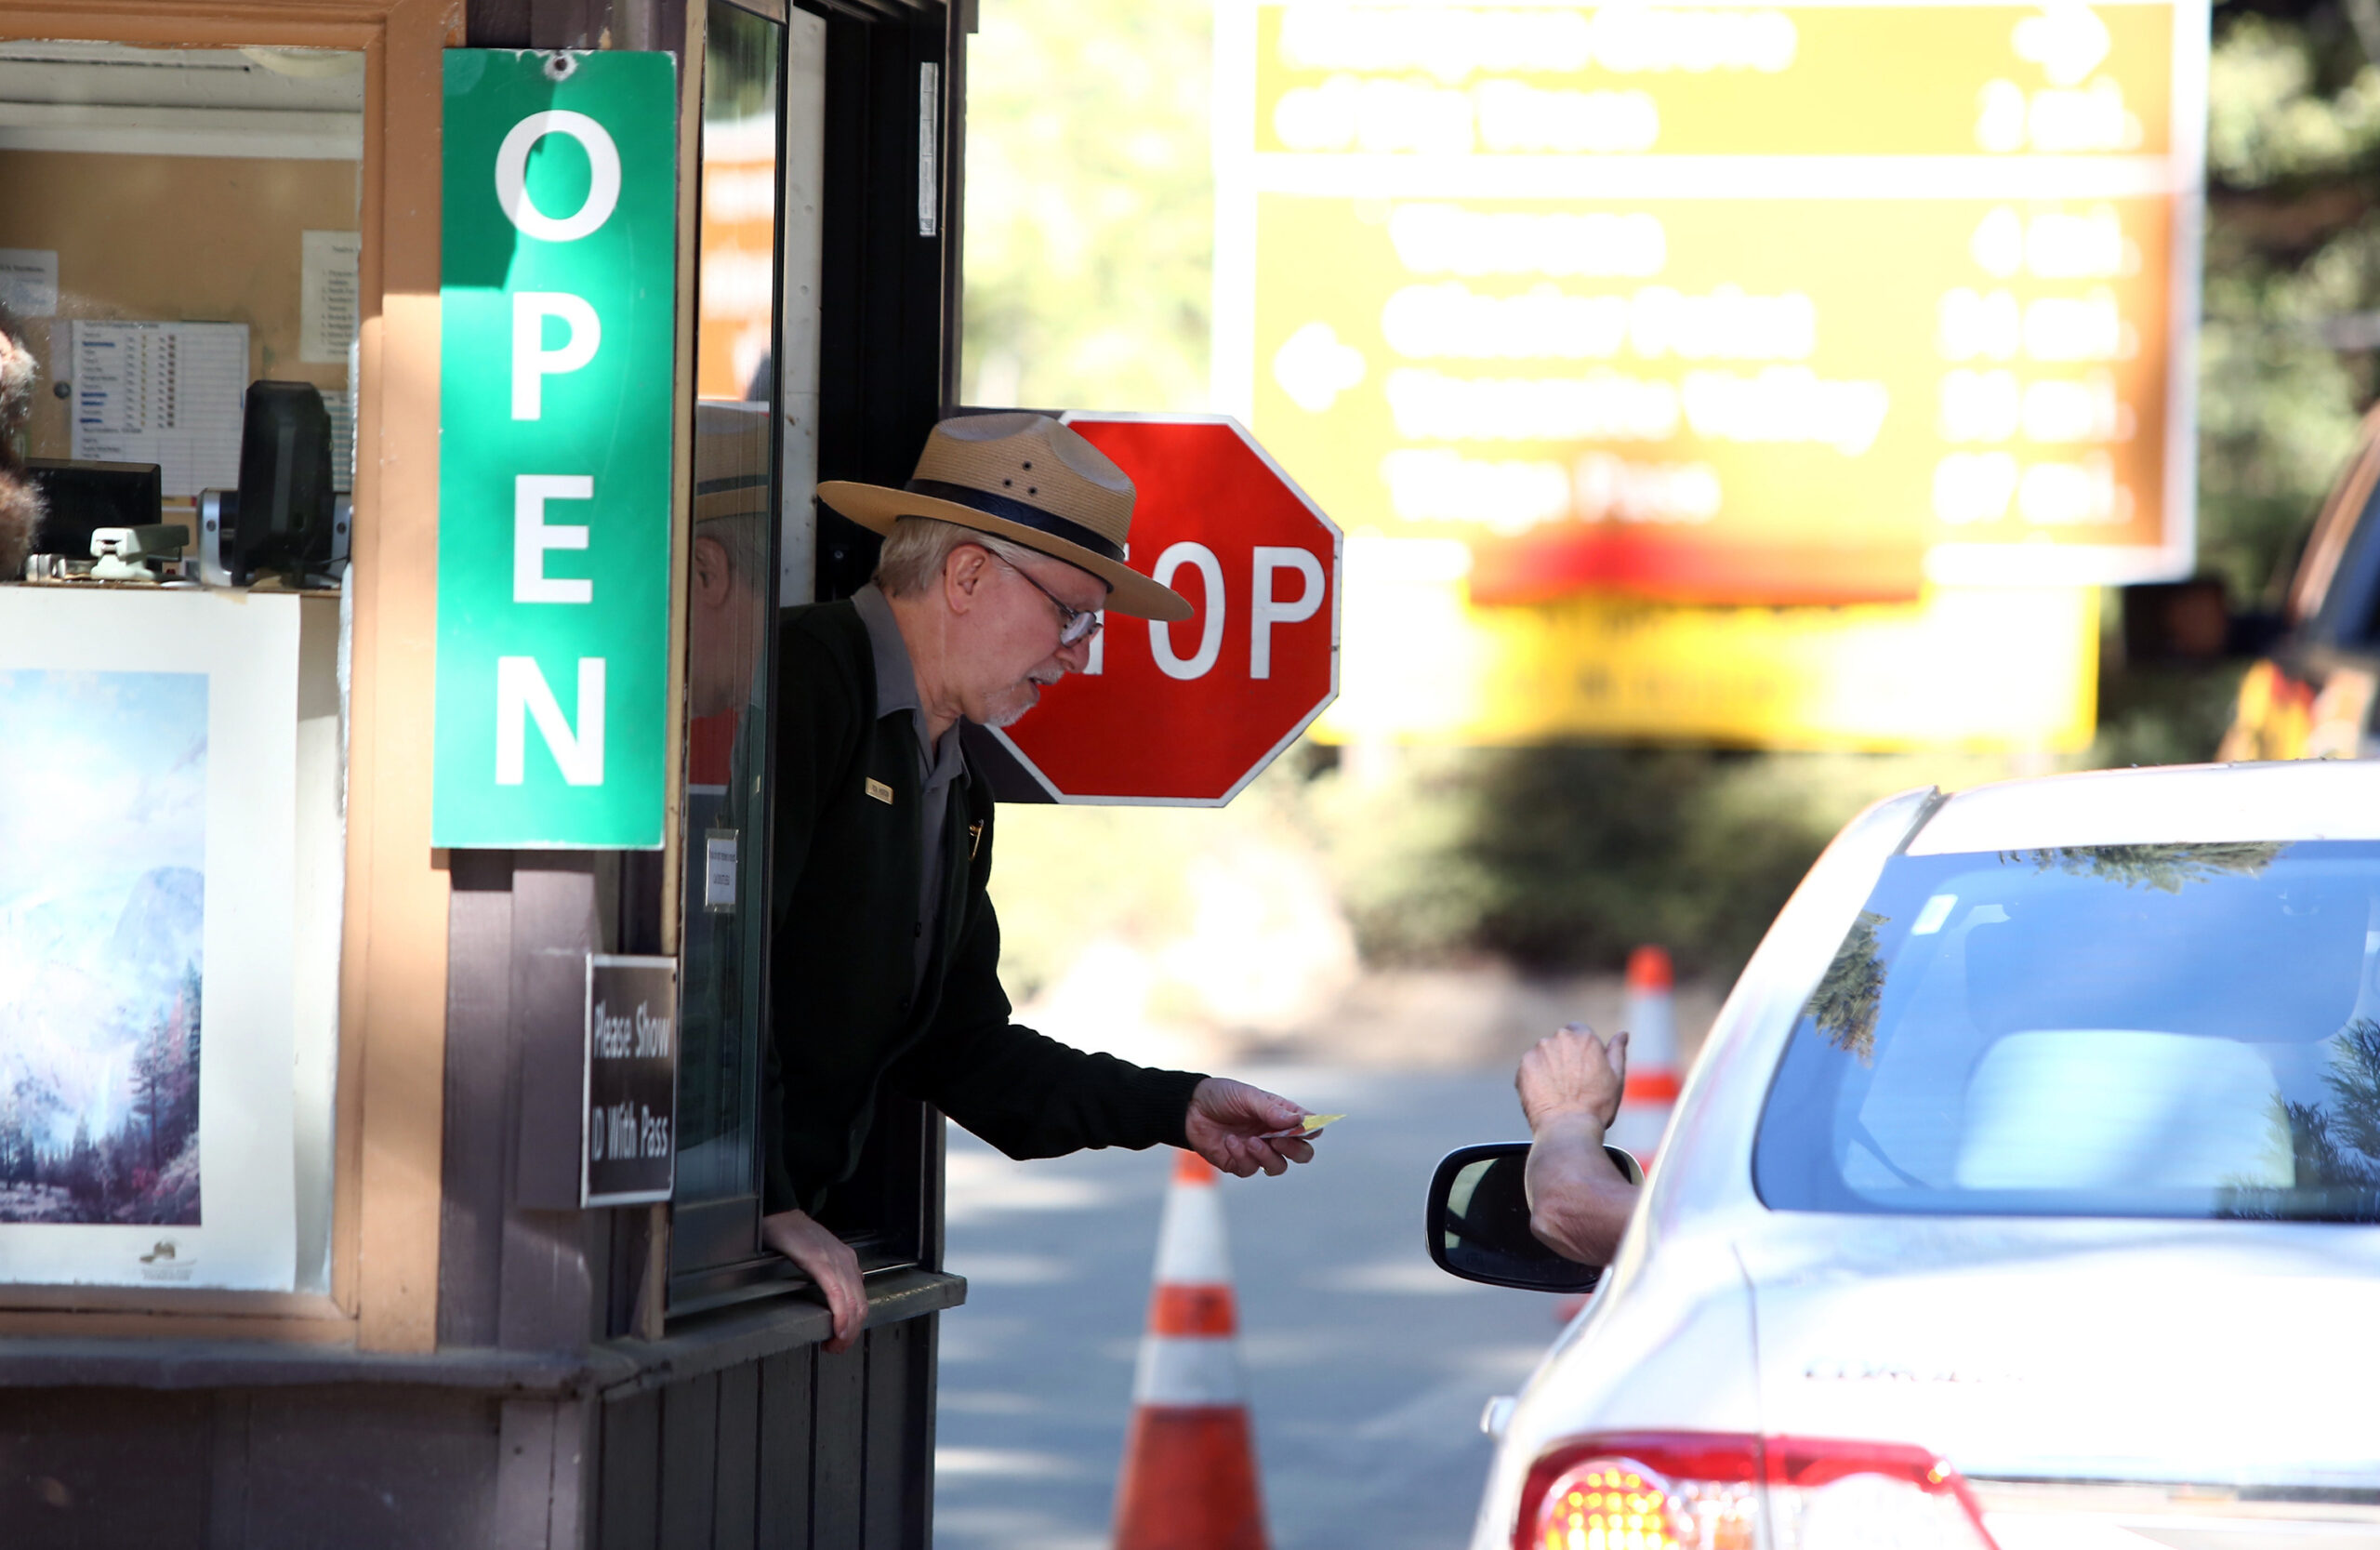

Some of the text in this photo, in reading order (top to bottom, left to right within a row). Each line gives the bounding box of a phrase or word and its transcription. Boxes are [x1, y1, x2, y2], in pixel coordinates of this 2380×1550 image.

[495, 110, 622, 787] OPEN
[1083, 541, 1326, 681] OP
[593, 1000, 671, 1059] Please Show
[591, 1102, 668, 1161] ID With Pass
